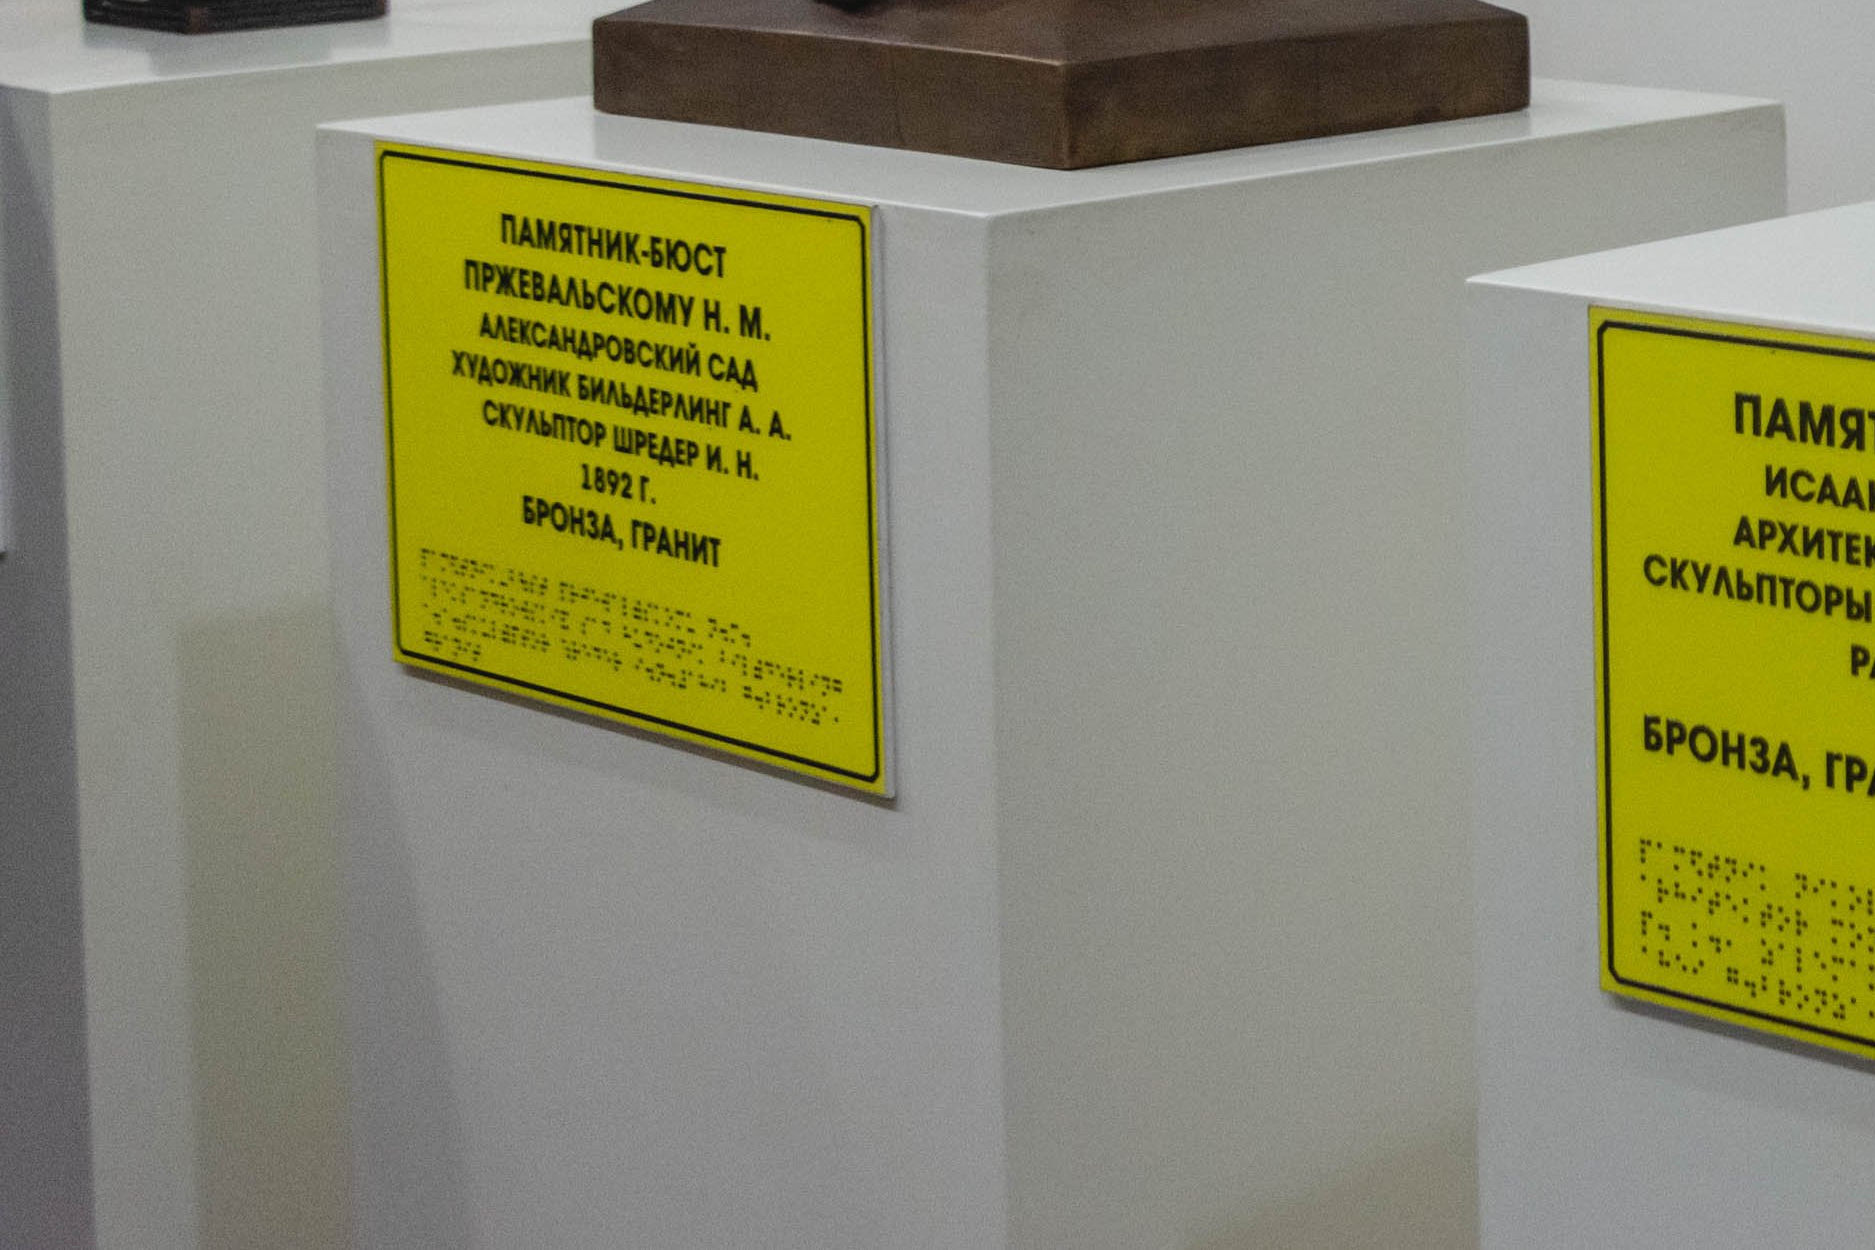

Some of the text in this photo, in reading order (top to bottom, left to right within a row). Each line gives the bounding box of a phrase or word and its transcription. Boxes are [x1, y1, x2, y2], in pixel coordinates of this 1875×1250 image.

[501, 213, 727, 278] ПАМЯТНИК-БЮСТ
[464, 259, 771, 341] ПРЖЕВАЛЬСКОМУ Н. М.
[480, 312, 758, 393] АЛЕКСАНДРОВСКИЙ САД
[452, 350, 792, 441] ХУДОЖНИК БИЛЬДЕРЛИНГ А. А.
[483, 400, 760, 481] СКУЛЬПТОР ШРЕДЕР И. Н.
[581, 463, 657, 504] 1892 Г.
[522, 495, 721, 568] БРОНЗА, ГРАНИТ
[1644, 555, 1872, 623] СКУЛЬПТОРЫ
[1644, 715, 1810, 791] БРОНЗА,
